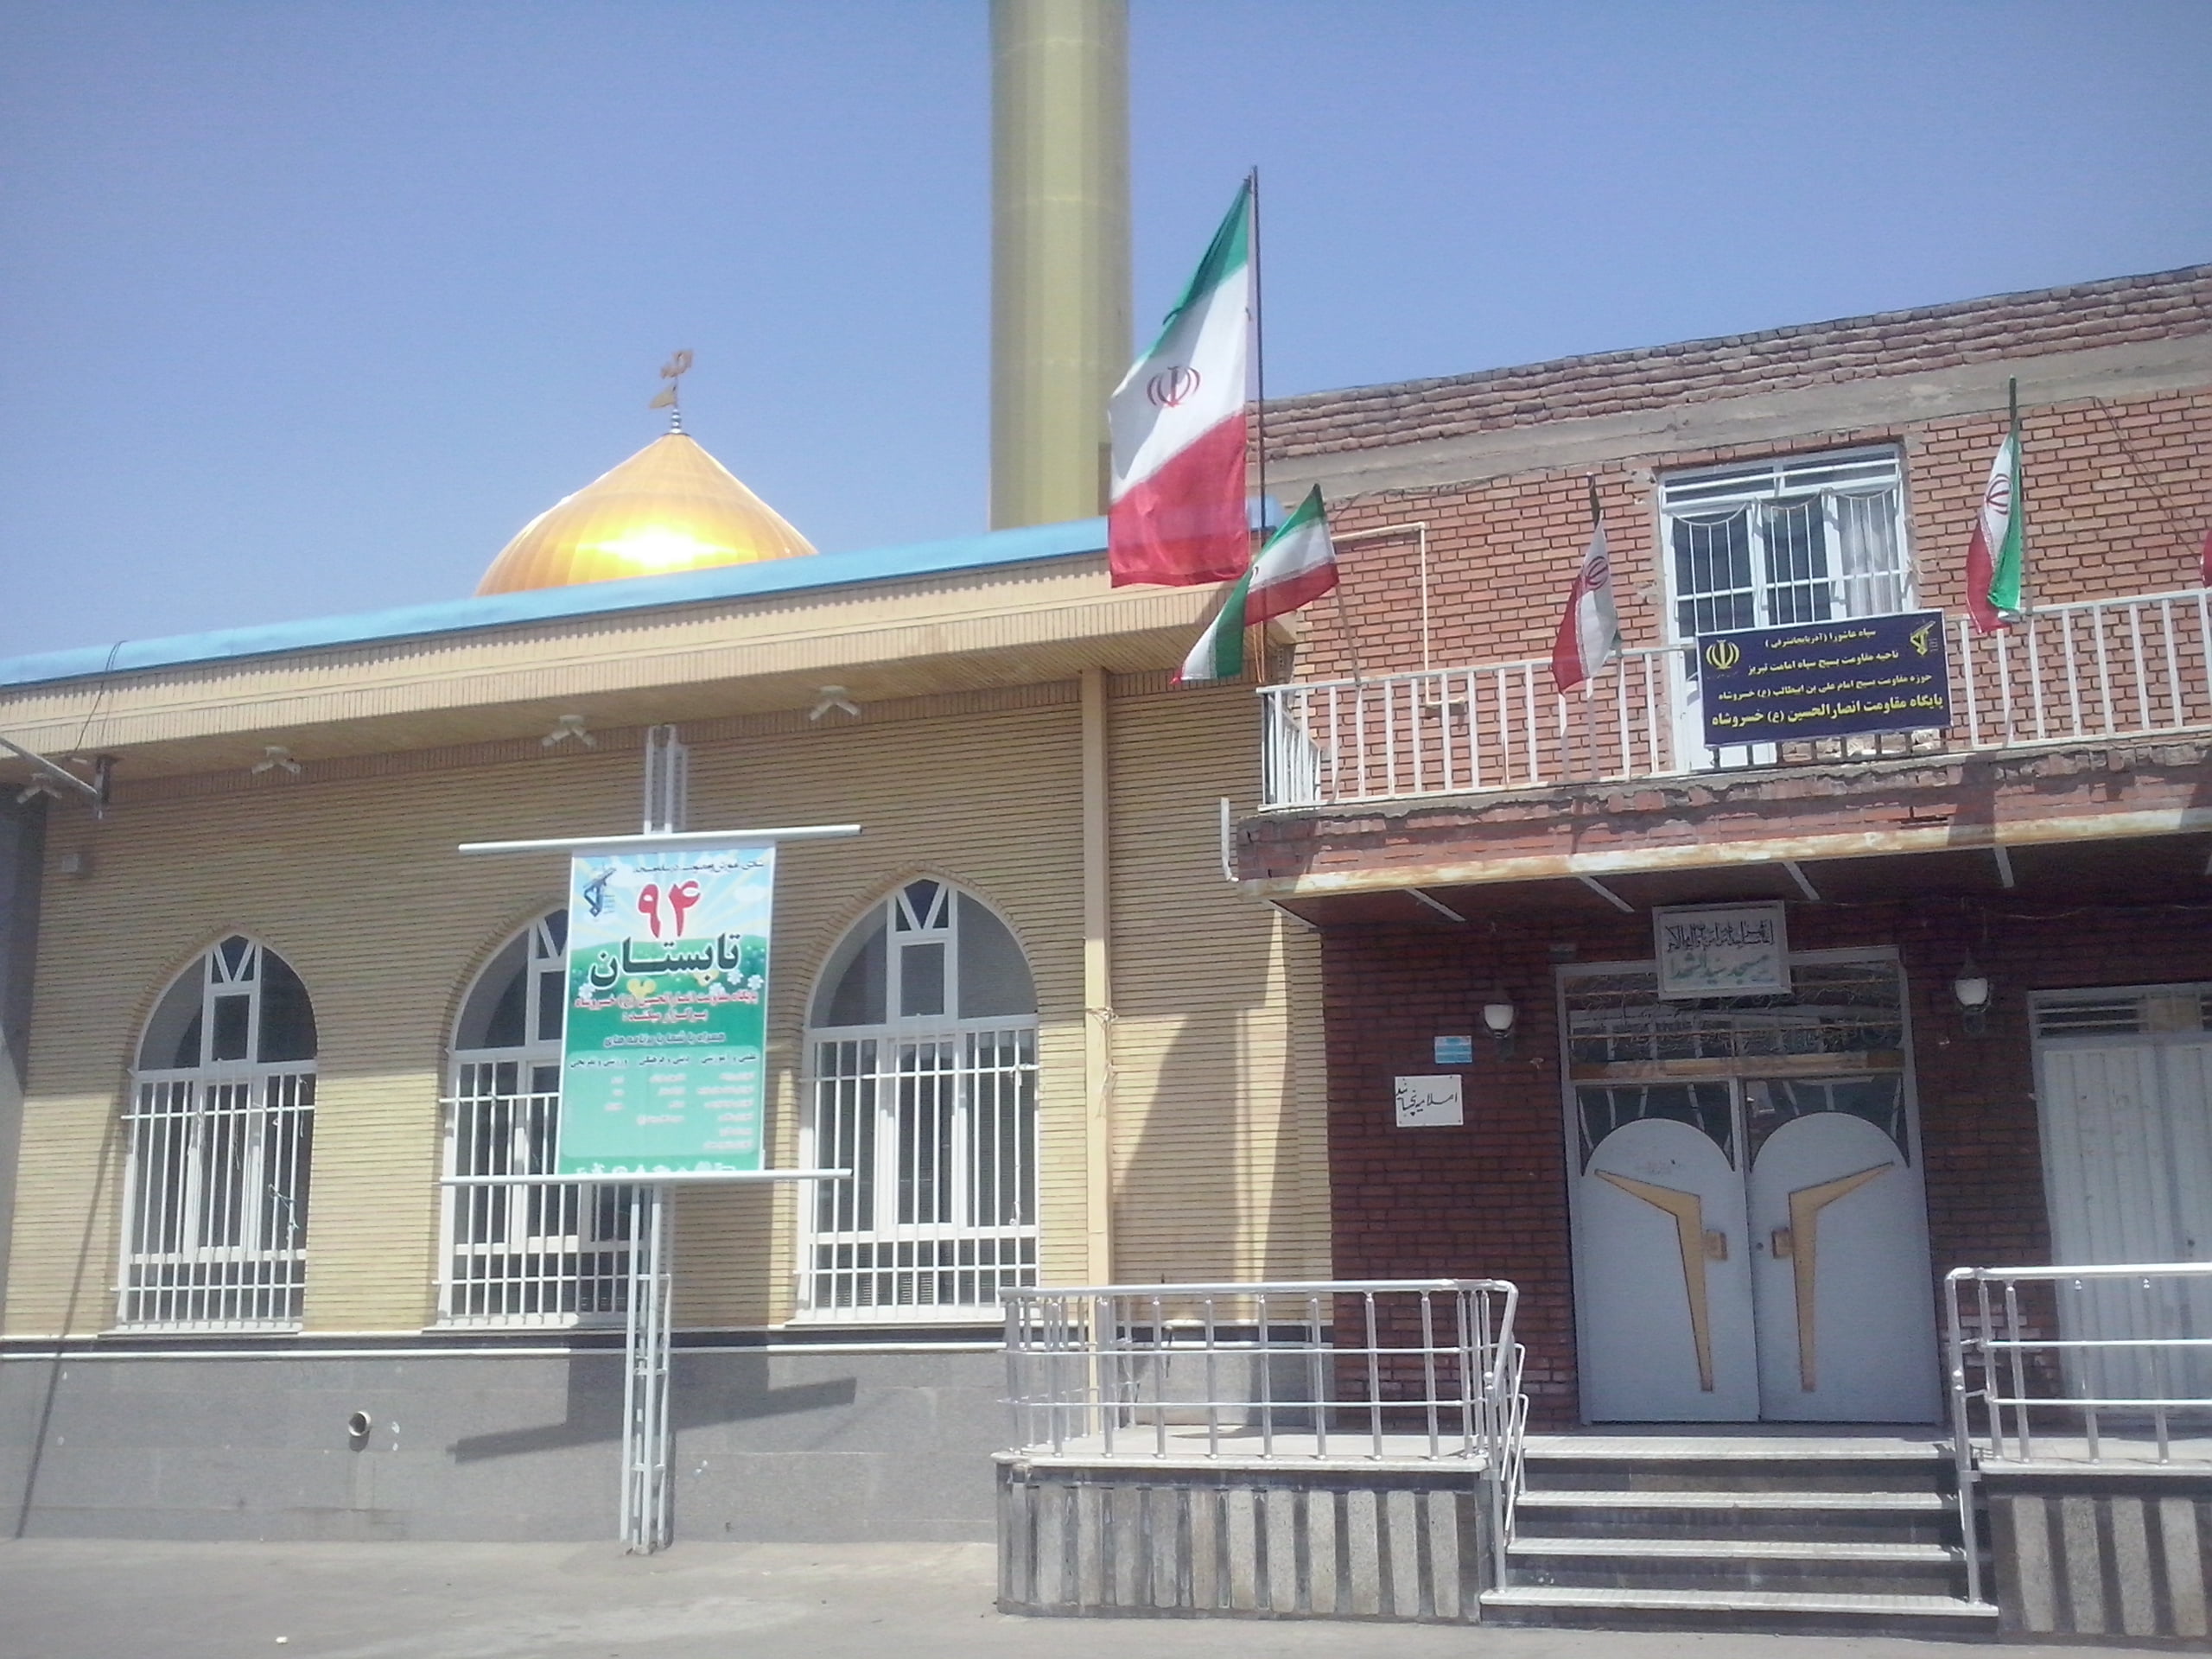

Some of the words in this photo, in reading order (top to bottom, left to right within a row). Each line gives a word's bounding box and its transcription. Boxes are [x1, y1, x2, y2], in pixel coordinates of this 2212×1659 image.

[1829, 630, 1857, 642] عاشورا
[1859, 627, 1876, 639] سپاه
[1841, 652, 1874, 664] مقاومت
[1876, 649, 1898, 661] ناحیه
[1747, 663, 1768, 676] تبریز
[1770, 660, 1796, 672] امامت
[1797, 658, 1816, 671] سپاه
[1818, 658, 1840, 669] بسیج
[1856, 679, 1875, 690] بسیج
[1878, 674, 1908, 686] مقاومت
[1910, 674, 1932, 684] حوزه
[1818, 683, 1835, 693] علی
[1837, 680, 1853, 691] امام
[1718, 690, 1755, 702] خسروشاه
[1910, 693, 1943, 710] پایگاه
[1864, 696, 1907, 714] مقاومت
[1712, 709, 1764, 728] خسروشاه
[589, 931, 741, 988] تابستان
